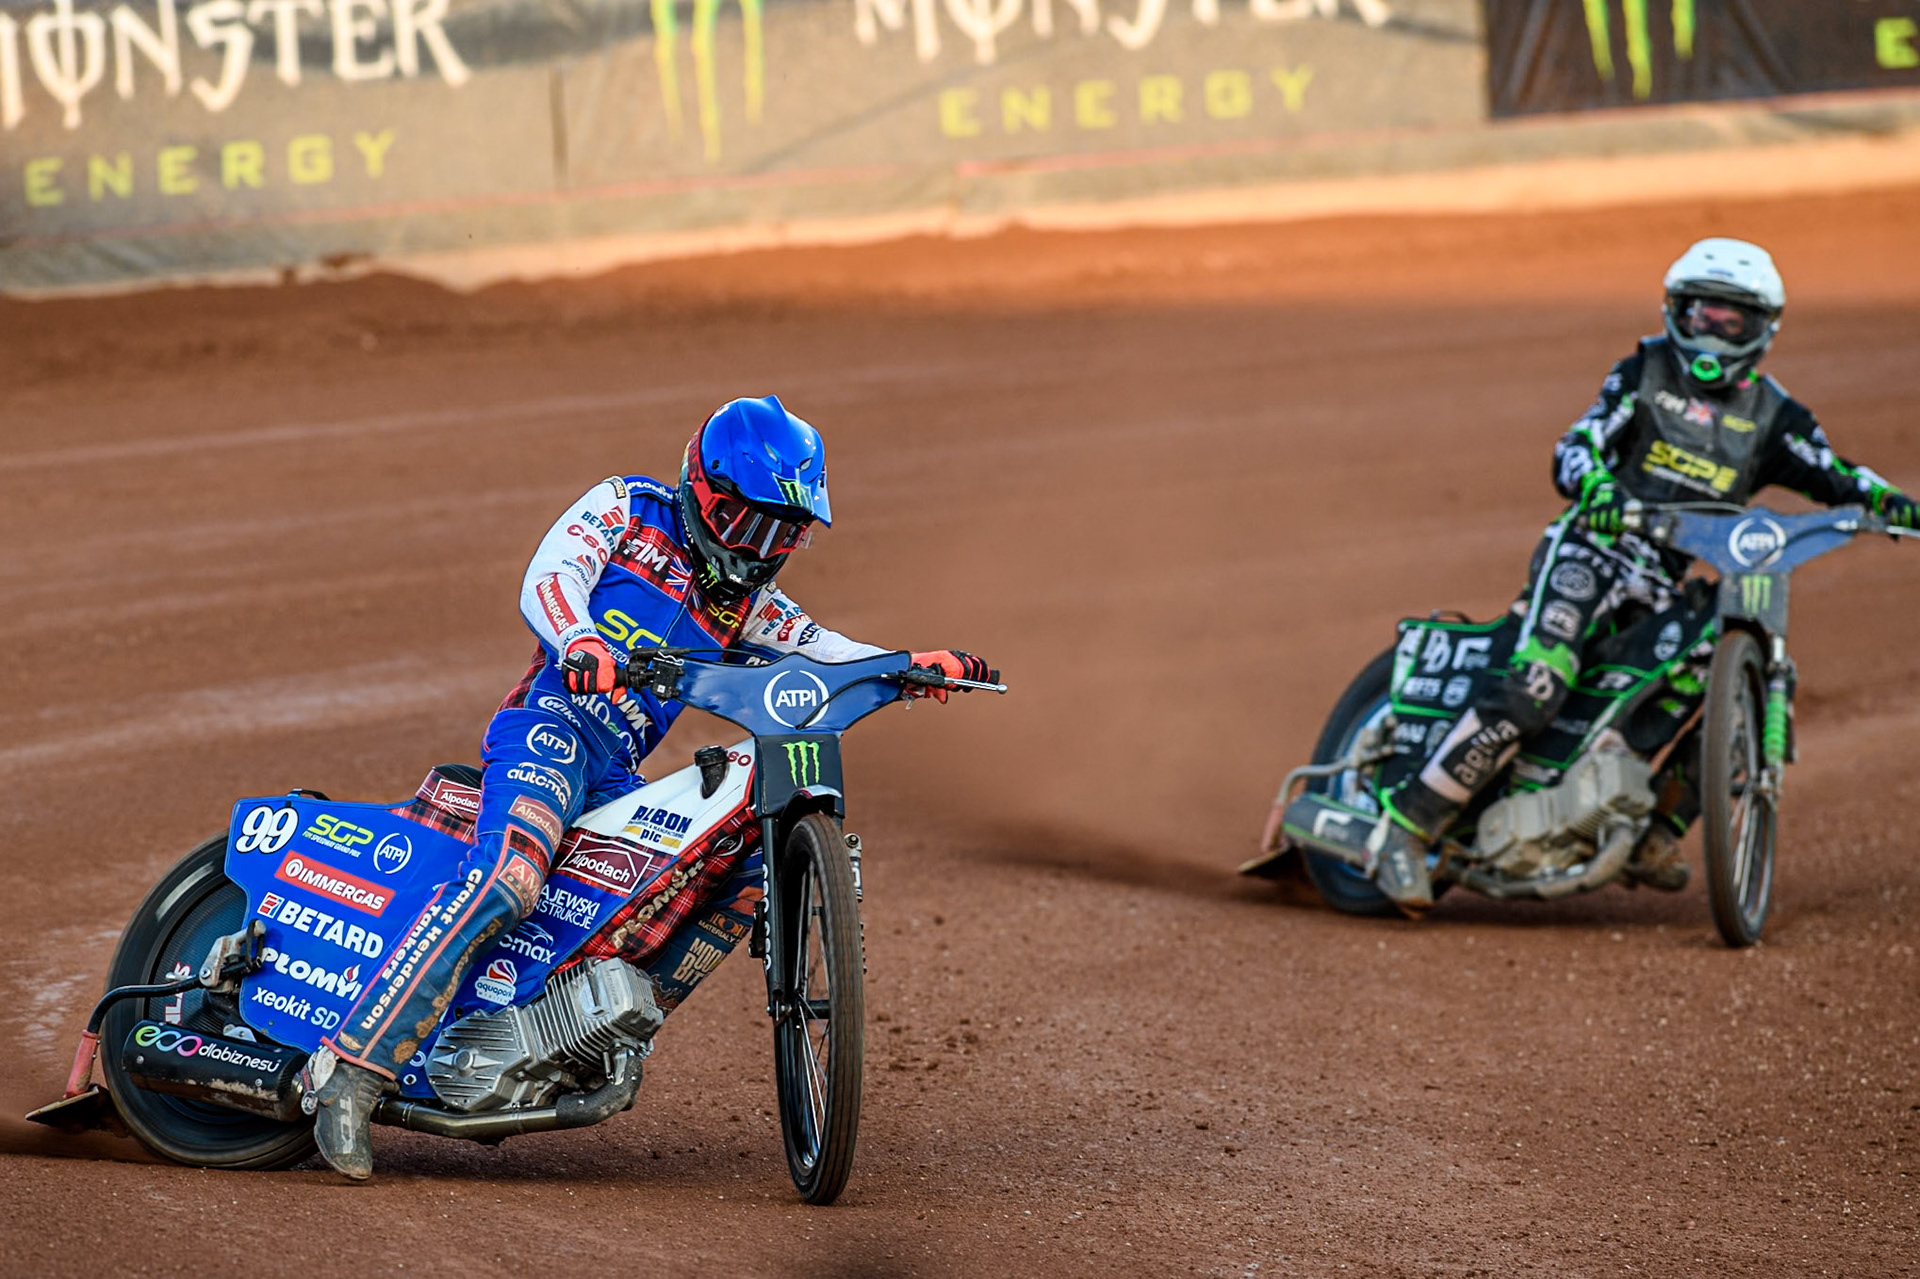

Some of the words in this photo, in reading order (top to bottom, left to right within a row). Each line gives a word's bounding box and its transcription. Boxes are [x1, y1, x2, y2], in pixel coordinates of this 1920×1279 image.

[0, 0, 471, 129] ONSTER
[939, 64, 1313, 139] ENERGY
[25, 131, 394, 206] ENERGY
[581, 511, 616, 552] BETAR
[1739, 532, 1776, 552] ATPI
[595, 609, 667, 651] SG
[775, 689, 817, 707] ATPI
[534, 731, 571, 755] ATPI
[727, 752, 752, 767] SO
[235, 805, 299, 854] 99
[307, 813, 375, 847] SGP
[515, 804, 559, 847] Alpodach
[631, 805, 693, 834] ALBON
[640, 828, 662, 843] plc
[378, 843, 407, 863] ATPI
[570, 854, 631, 884] Alpodach
[298, 867, 386, 910] IMMERGAS
[440, 868, 483, 925] Grant
[540, 883, 601, 918] AJEWSKI
[276, 899, 384, 959] BETARD
[534, 898, 596, 931] NSTRUKCJE
[381, 903, 443, 981] Tankers
[360, 925, 443, 1030] Henderson
[477, 982, 512, 997] aquapark
[251, 986, 312, 1021] xeokit
[310, 1009, 341, 1031] SD
[135, 1025, 203, 1057] eco
[198, 1042, 283, 1073] dlabiznesu
